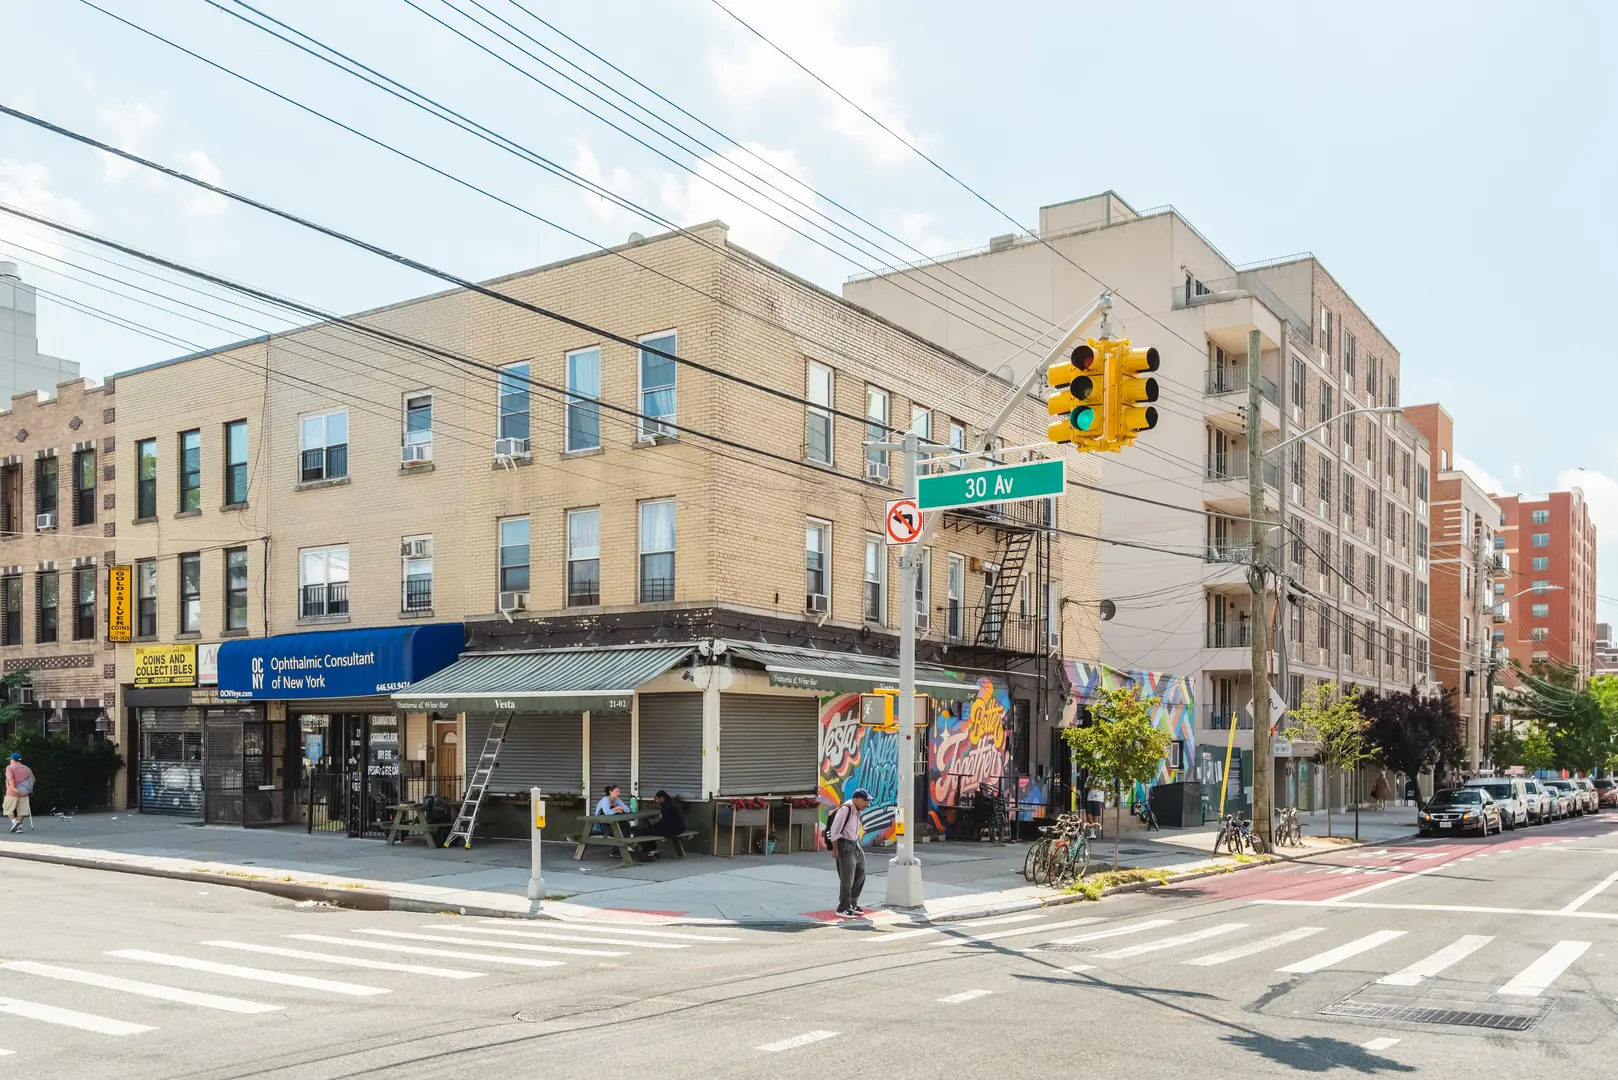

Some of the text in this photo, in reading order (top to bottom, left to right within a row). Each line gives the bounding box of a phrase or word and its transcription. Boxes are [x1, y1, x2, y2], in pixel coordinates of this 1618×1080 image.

[965, 475, 1014, 498] 30 Av
[116, 571, 124, 591] GOLD
[116, 596, 124, 625] SILVER
[143, 654, 186, 666] COINS AND
[252, 657, 264, 673] OC
[270, 651, 375, 673] Ophthalmic Consultant
[136, 664, 193, 676] COLLECTIBLES
[252, 673, 264, 689] NY
[271, 674, 326, 689] of New York
[220, 690, 253, 698] OCNYeye.com
[396, 701, 417, 709] Trattoria
[424, 701, 438, 709] Wine
[494, 700, 516, 709] Vesta
[609, 699, 627, 708] 21-02
[819, 710, 860, 767] Vesta
